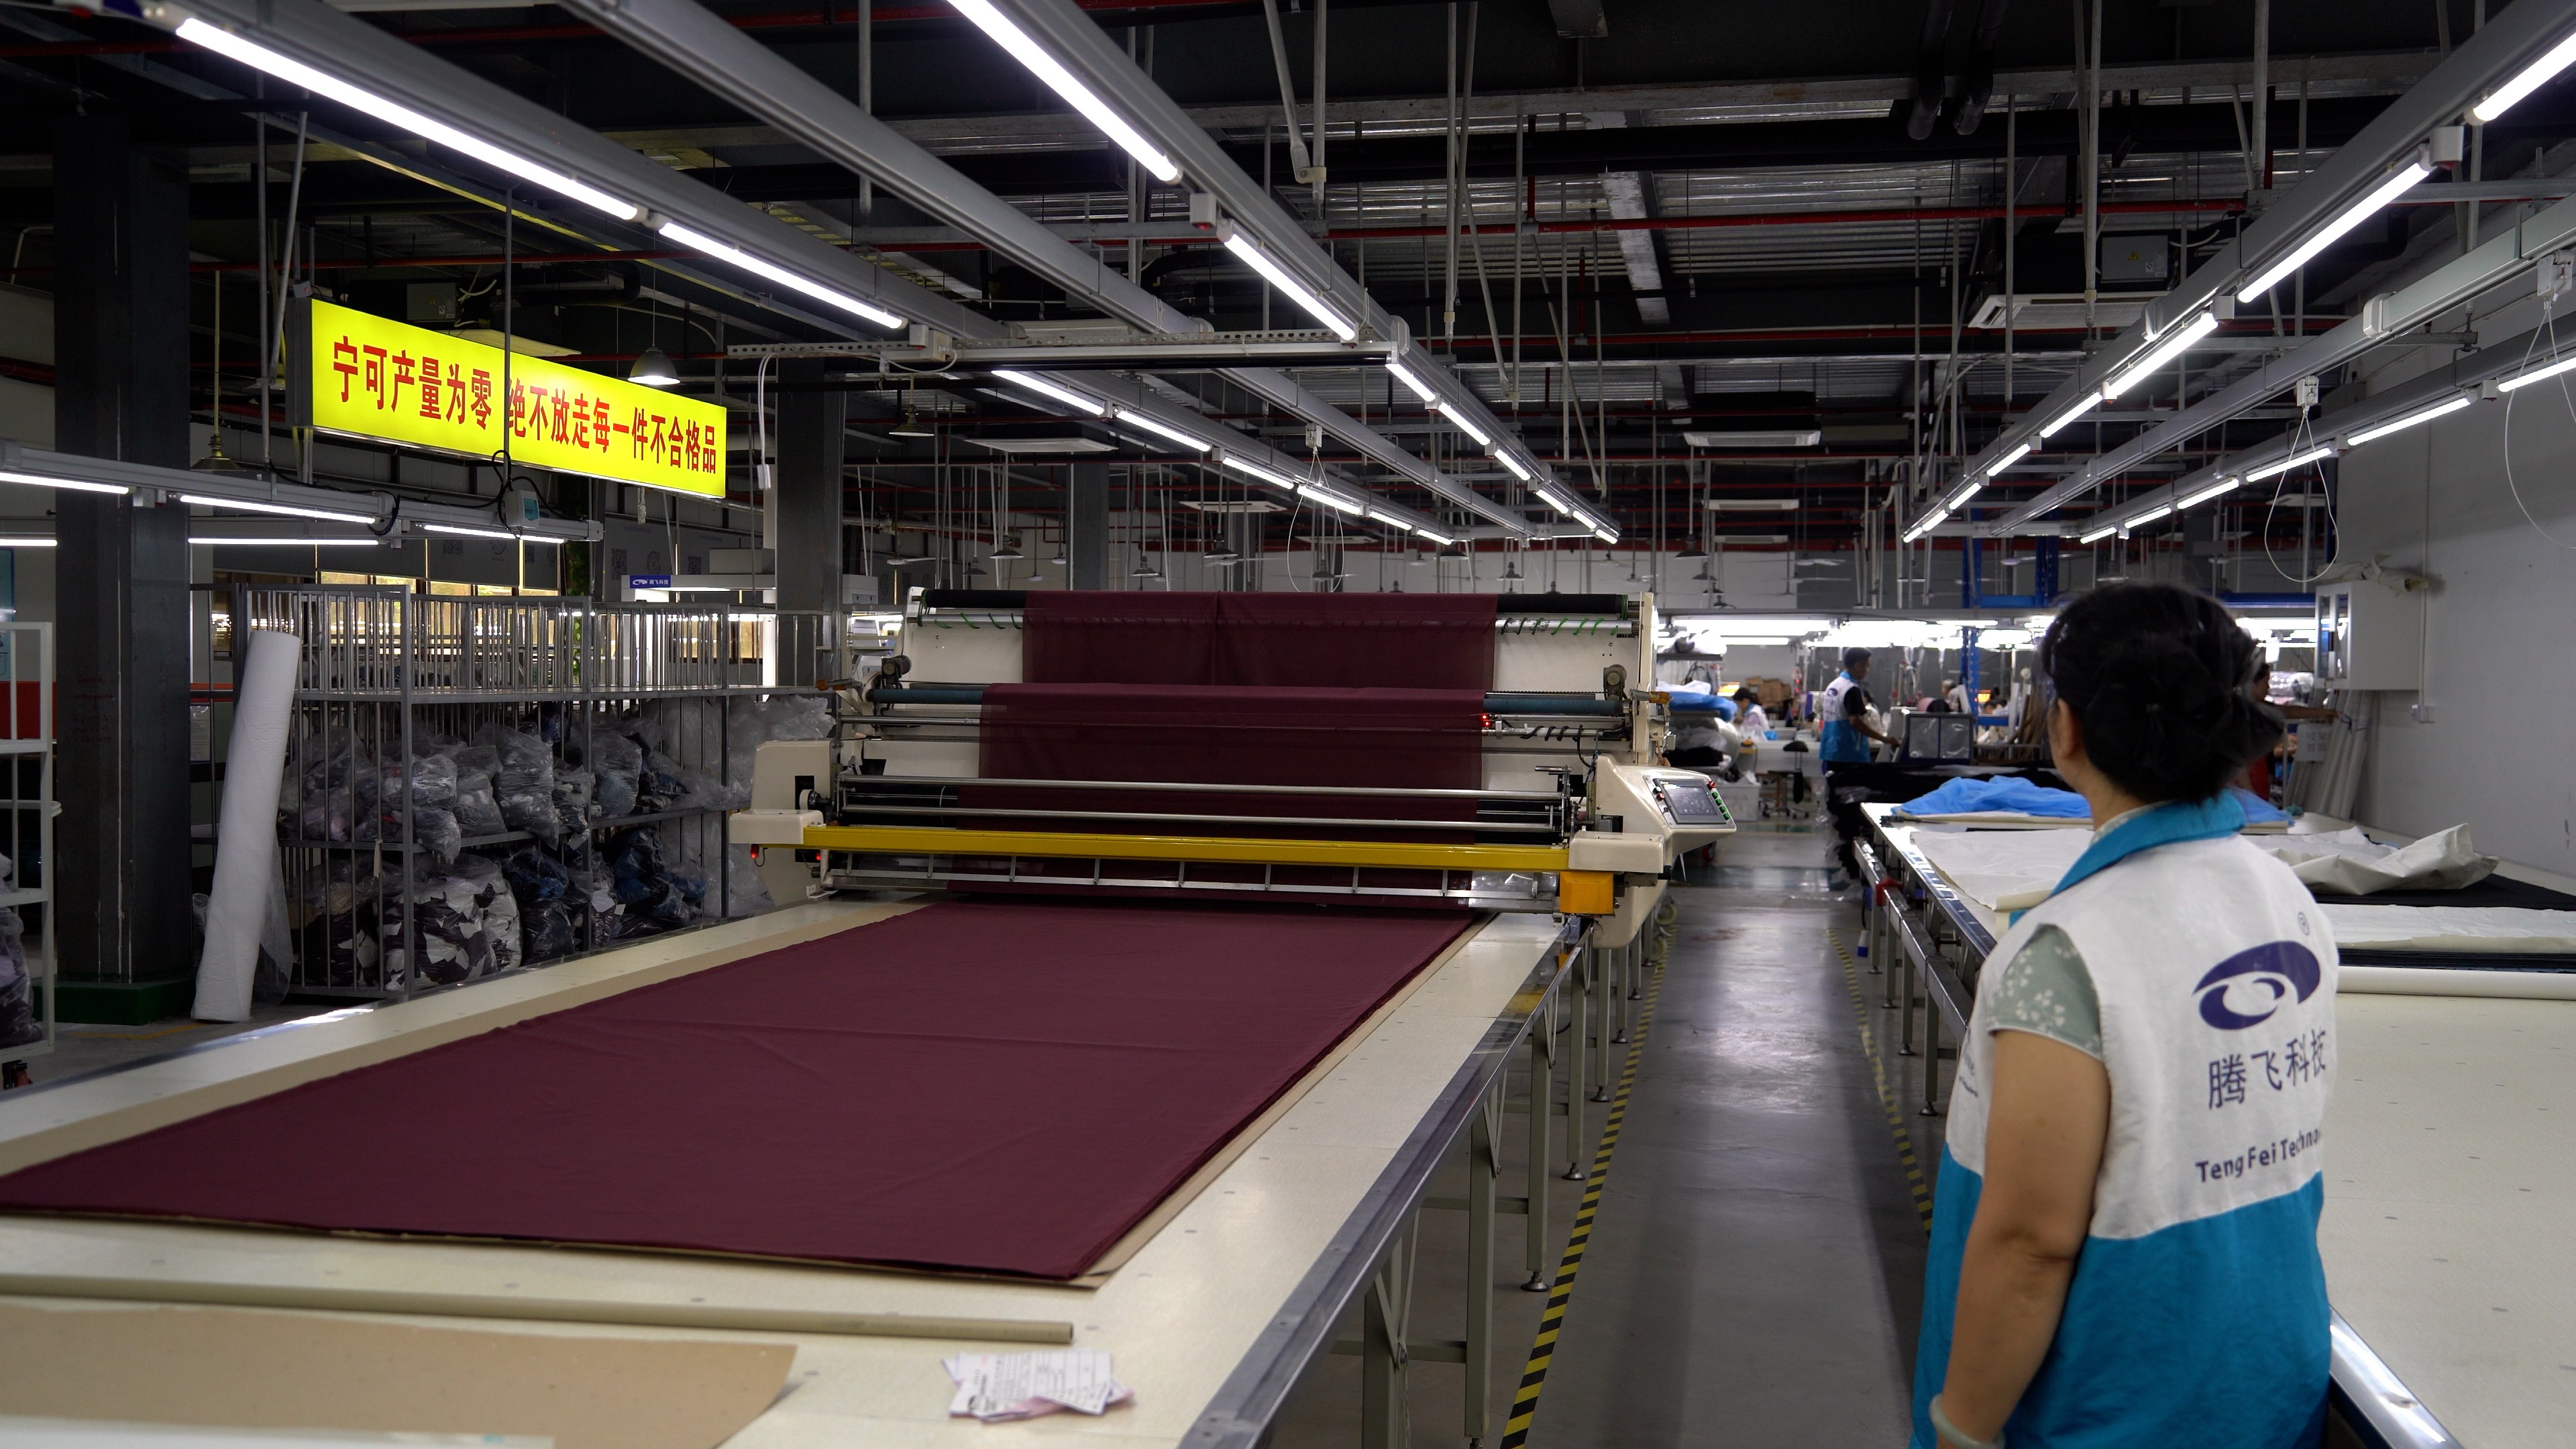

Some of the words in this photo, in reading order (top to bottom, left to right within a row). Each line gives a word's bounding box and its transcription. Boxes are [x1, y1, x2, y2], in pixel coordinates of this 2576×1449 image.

[333, 335, 492, 431] 宁可产量为零
[508, 378, 716, 474] 绝不放走每一件不合格品
[2208, 1028, 2326, 1110] 腾飞科技
[2280, 1128, 2320, 1161] Techno
